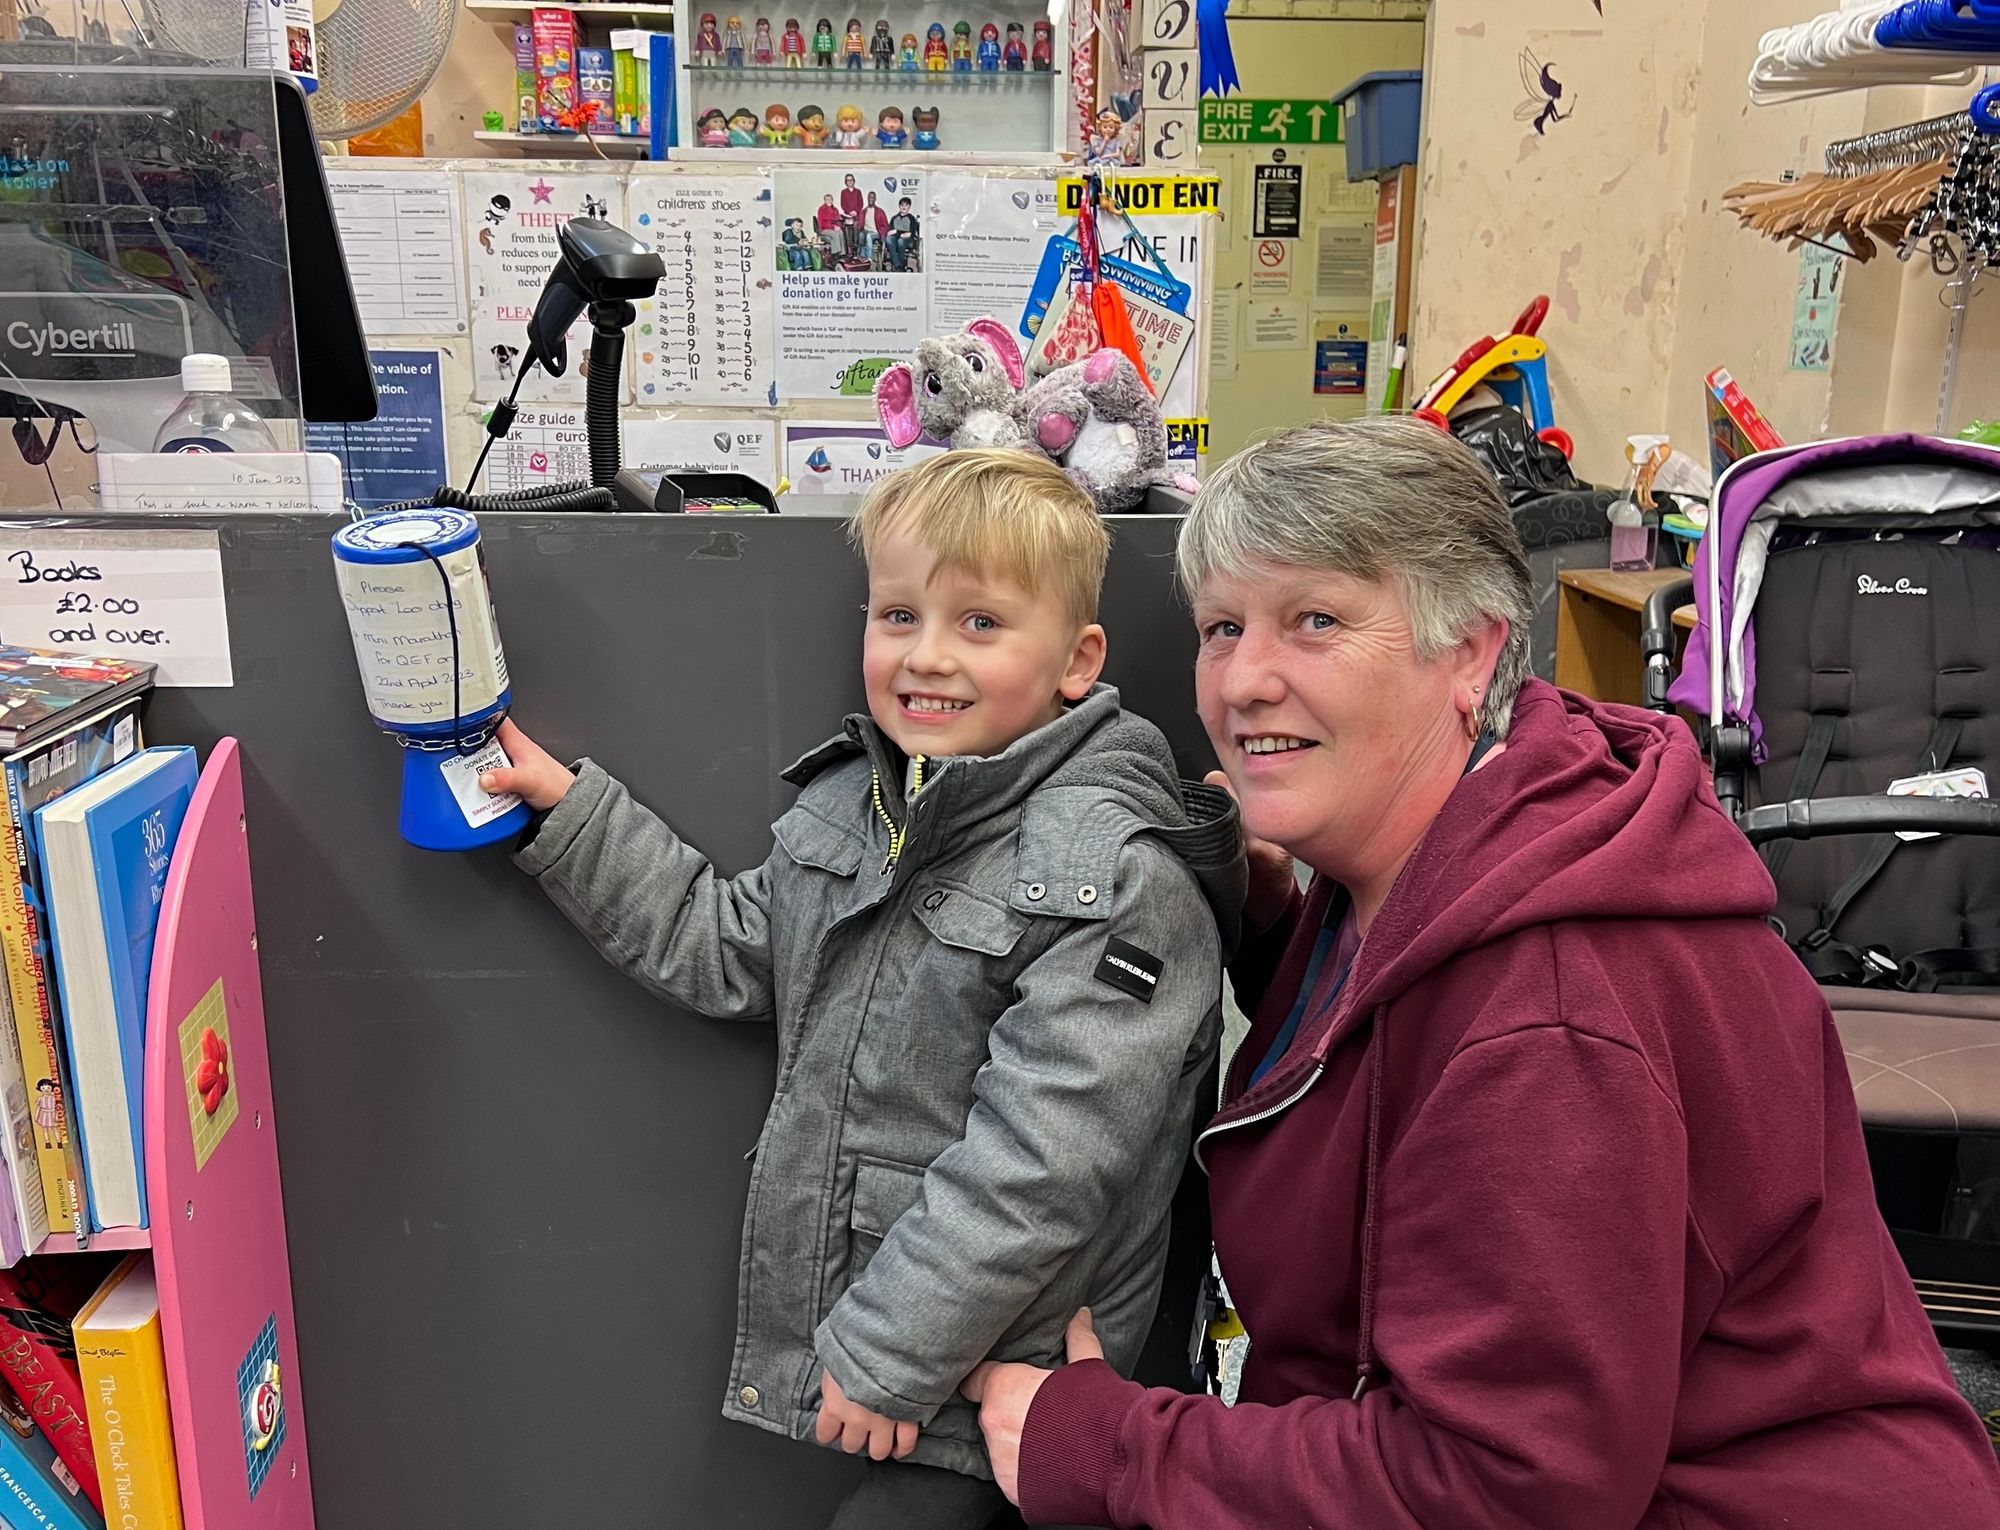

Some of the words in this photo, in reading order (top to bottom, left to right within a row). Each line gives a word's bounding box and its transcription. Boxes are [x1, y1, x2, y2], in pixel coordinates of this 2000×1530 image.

[1203, 103, 1253, 119] FIRE
[1203, 124, 1252, 140] EXIT
[1263, 168, 1294, 179] FIRE
[901, 178, 920, 187] QEF
[1115, 184, 1165, 209] NOT
[1174, 182, 1219, 208] ENT
[711, 200, 741, 211] shoes
[517, 212, 575, 227] THEFT
[511, 233, 536, 243] from
[538, 233, 556, 243] this
[684, 230, 692, 242] 4
[740, 230, 752, 243] 12
[501, 249, 539, 258] reduces
[542, 250, 559, 258] our
[502, 264, 512, 272] to
[515, 263, 551, 275] support
[685, 259, 693, 271] 5
[741, 260, 751, 272] 13
[517, 278, 541, 287] need
[743, 273, 746, 285] 1
[782, 274, 809, 287] Help
[812, 276, 826, 286] us
[828, 275, 860, 286] make
[863, 277, 889, 288] your
[1100, 263, 1172, 300] SWIMMING
[686, 286, 694, 298] 6
[782, 287, 834, 299] donation
[836, 290, 851, 301] go
[854, 288, 893, 299] further
[686, 299, 695, 310] 7
[742, 301, 750, 312] 2
[497, 306, 534, 318] PLEA
[687, 312, 695, 323] 8
[743, 315, 751, 326] 3
[1124, 299, 1183, 344] TIME
[7, 322, 136, 357] Cybertill
[744, 329, 751, 340] 4
[687, 339, 695, 351] 9
[744, 342, 752, 354] 5
[688, 353, 700, 365] 10
[371, 363, 385, 375] he
[386, 363, 418, 375] value
[420, 362, 433, 375] of
[690, 367, 698, 380] 11
[744, 368, 752, 381] 6
[830, 358, 891, 390] giftai
[377, 383, 408, 395] ation.
[512, 412, 535, 424] ize
[538, 413, 576, 426] guide
[507, 430, 522, 441] uk
[555, 432, 587, 442] euro
[737, 434, 763, 445] QEF
[640, 462, 682, 470] Customer
[684, 461, 729, 471] behaviour
[731, 462, 739, 471] in
[232, 473, 243, 484] 10
[276, 474, 302, 485] 2023
[135, 494, 157, 509] This
[8, 550, 102, 583] Books
[361, 581, 405, 594] Please
[1857, 574, 1893, 596] Silver
[1894, 578, 1928, 595] Cross
[56, 592, 140, 614] £2.00
[50, 623, 96, 643] and
[106, 628, 171, 645] over.
[396, 653, 432, 666] QEF
[374, 698, 413, 709] Thank
[6, 768, 16, 796] BISLEY
[11, 798, 21, 828] GRANT
[142, 809, 166, 858] 365
[15, 830, 27, 867] WAGNER
[26, 904, 39, 947] BATMAN
[72, 1211, 84, 1240] BOOKS
[0, 1334, 86, 1434] BEAST
[98, 1374, 116, 1407] The
[102, 1409, 127, 1472] O'Clock
[0, 1466, 47, 1523] FRANCESCA
[115, 1474, 134, 1511] Tales
